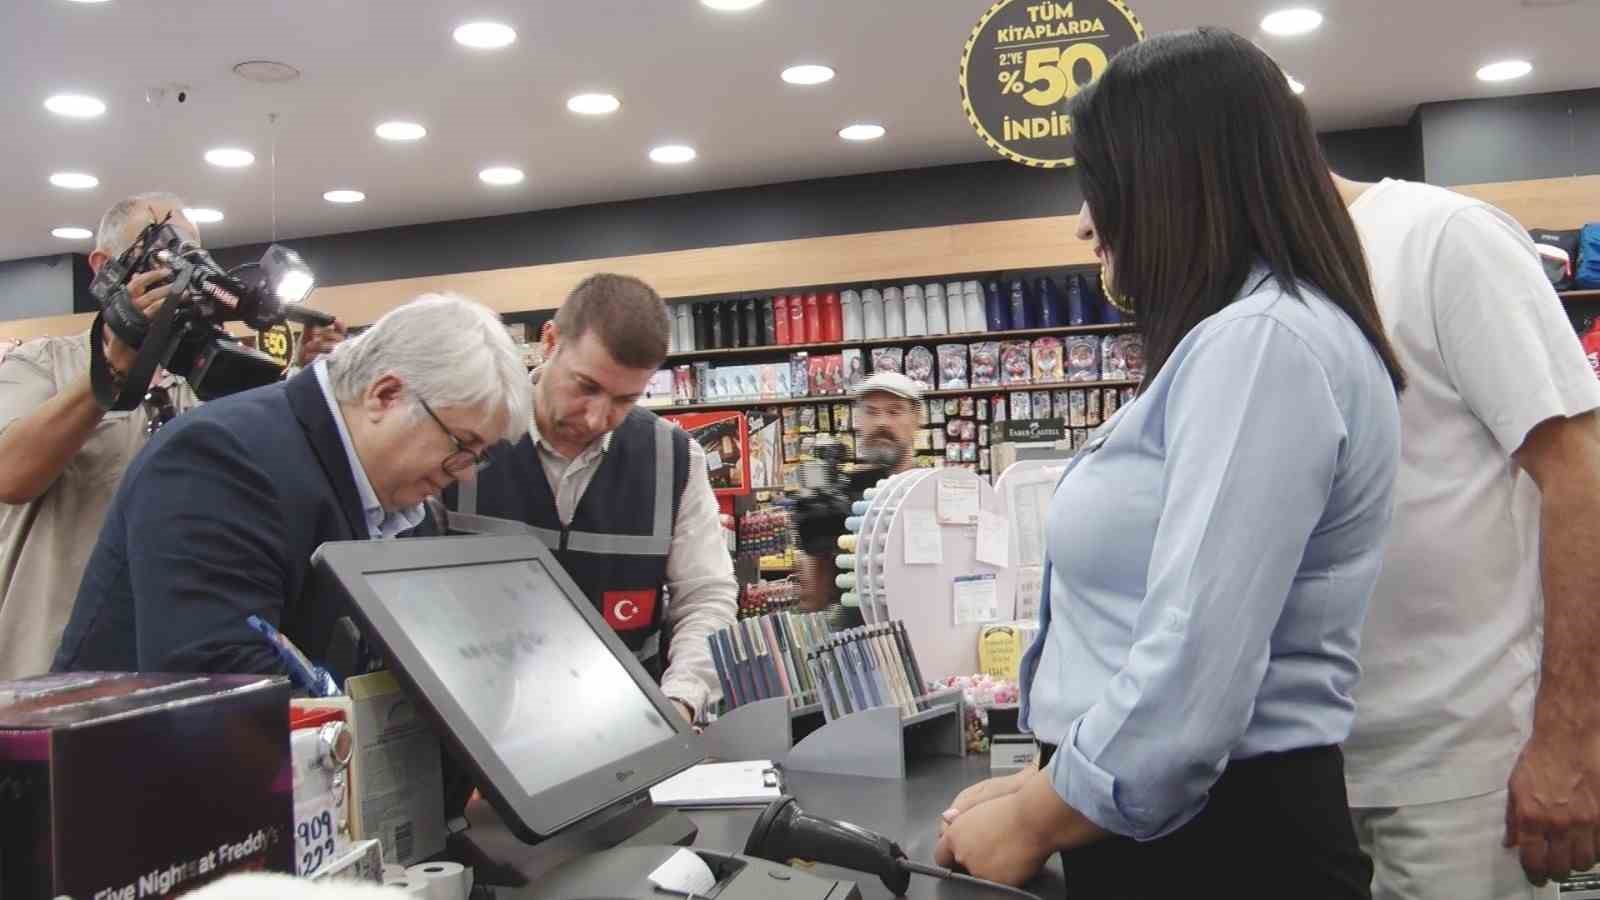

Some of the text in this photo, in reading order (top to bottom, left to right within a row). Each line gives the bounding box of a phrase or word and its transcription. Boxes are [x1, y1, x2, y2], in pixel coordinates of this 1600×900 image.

[1027, 2, 1073, 22] TÜM
[998, 18, 1105, 43] KİTAPLARDA
[1003, 111, 1072, 141] İNDİR
[297, 810, 332, 847] 909
[198, 851, 217, 874] at
